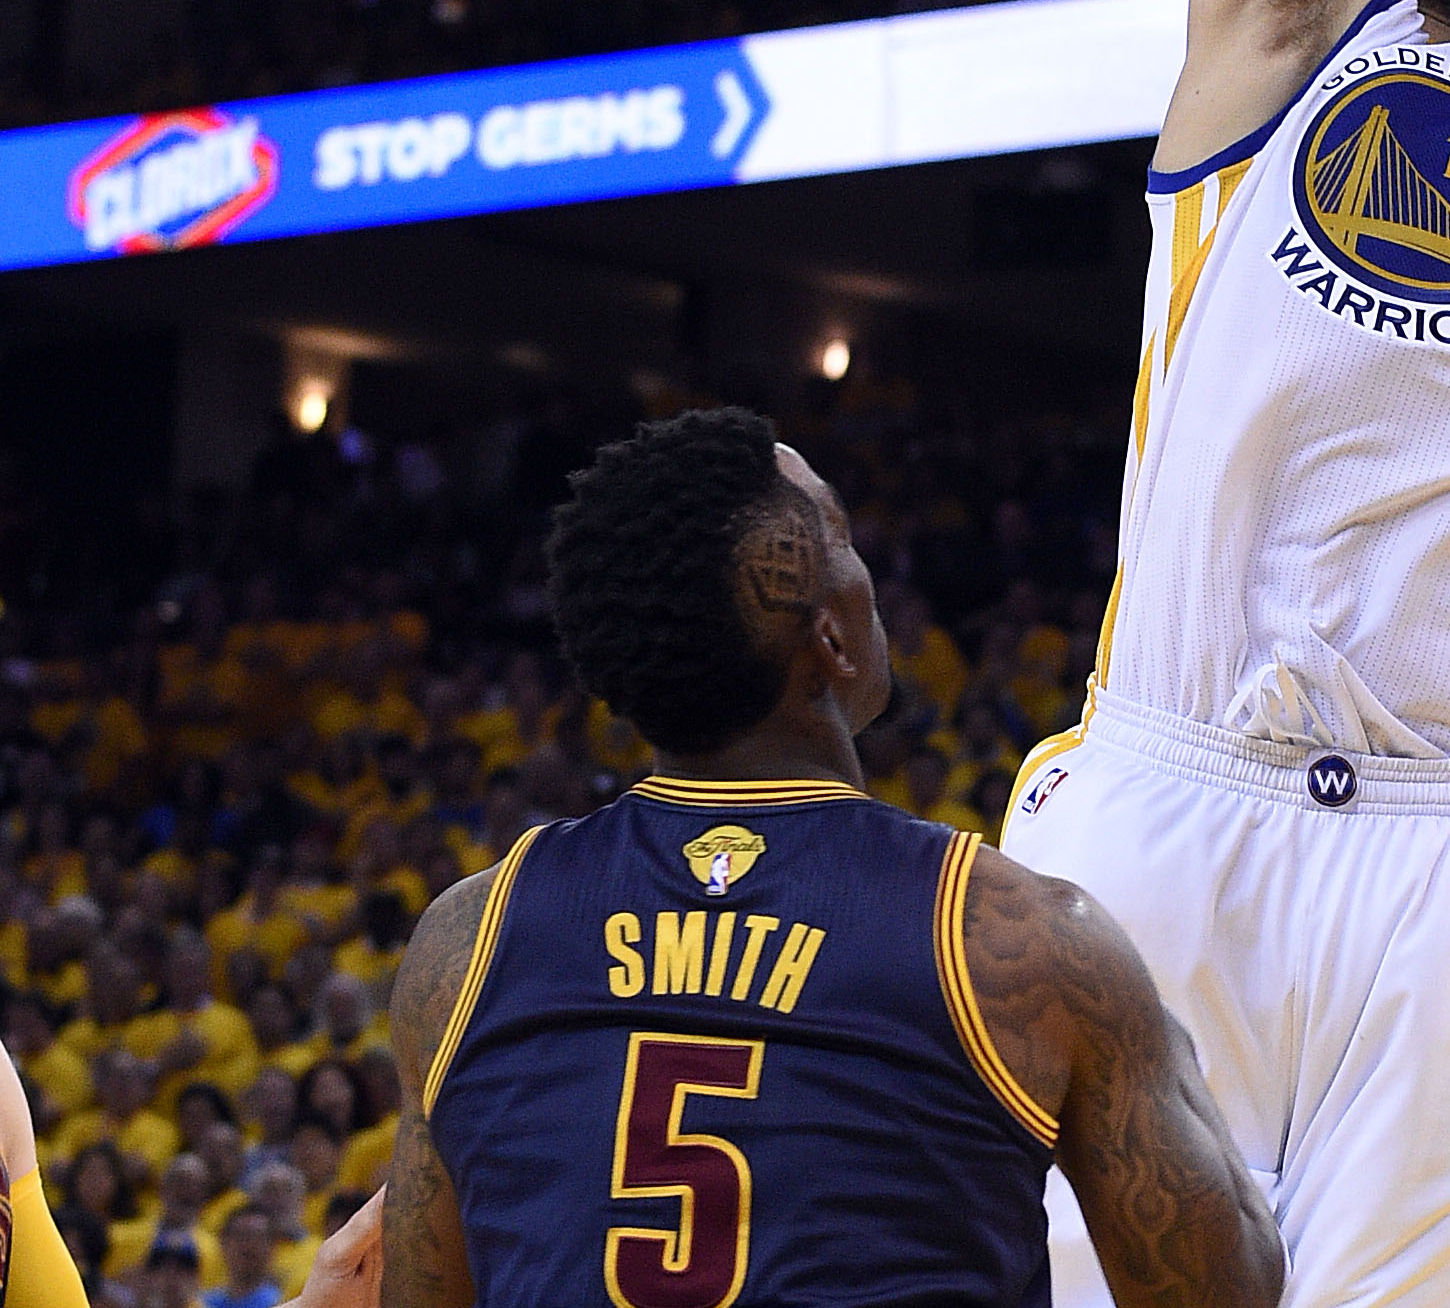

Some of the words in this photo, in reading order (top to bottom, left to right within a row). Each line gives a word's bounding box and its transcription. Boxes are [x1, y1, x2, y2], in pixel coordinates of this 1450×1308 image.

[314, 113, 472, 192] STOP
[477, 86, 688, 172] GERMS
[604, 910, 827, 1015] SMITH
